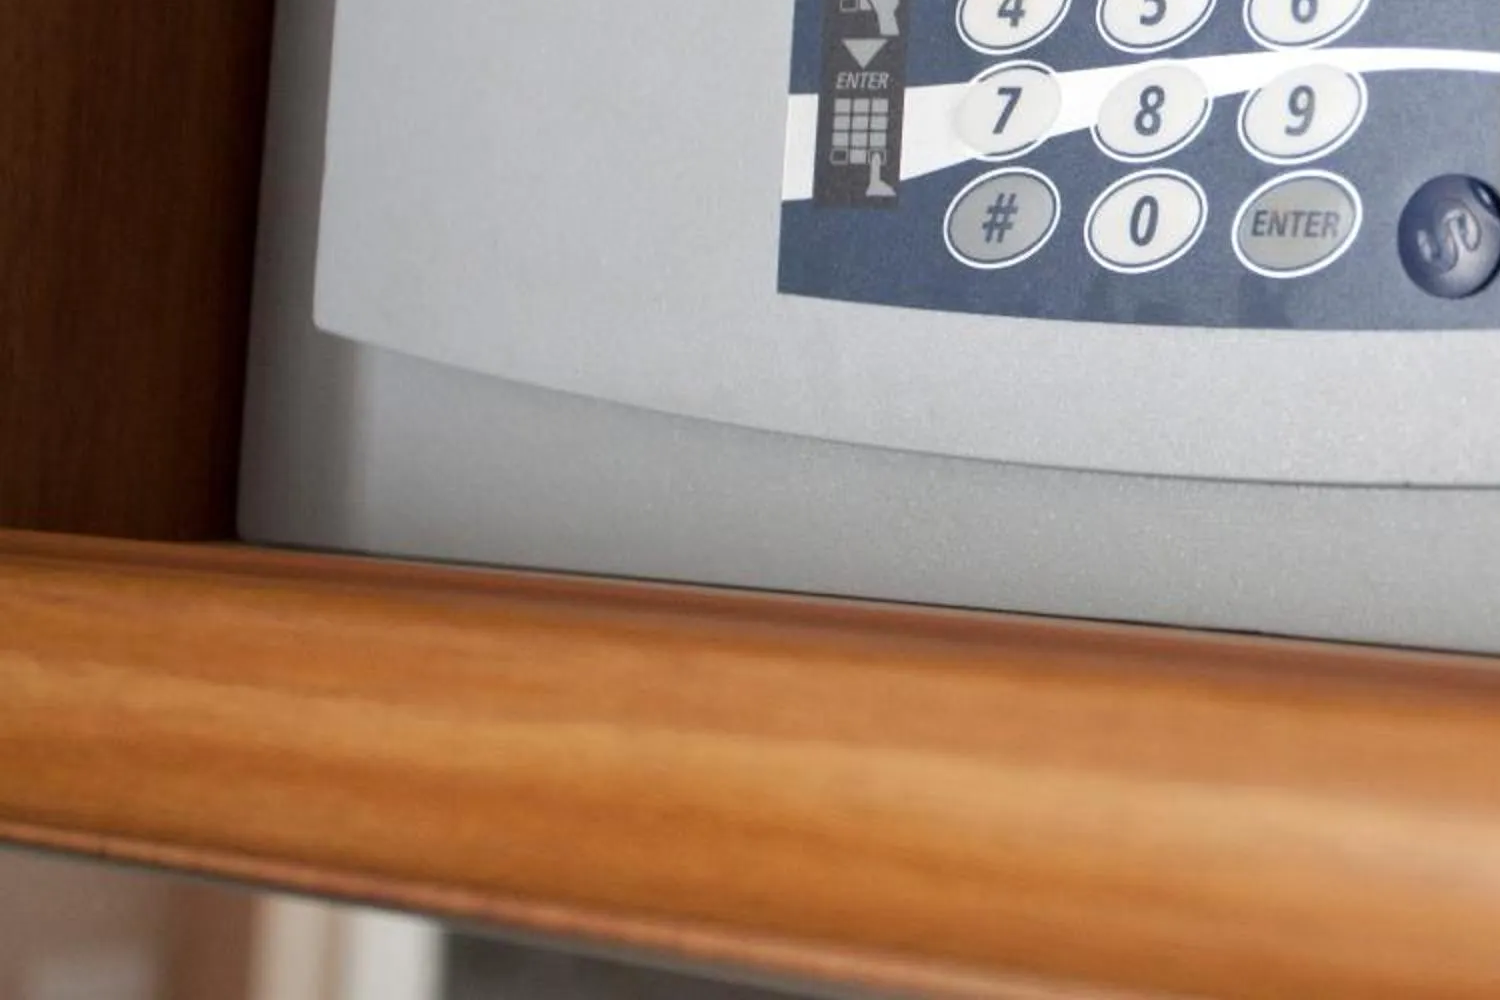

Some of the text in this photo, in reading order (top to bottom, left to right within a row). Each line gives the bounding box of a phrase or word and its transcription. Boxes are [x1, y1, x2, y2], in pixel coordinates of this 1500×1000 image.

[835, 71, 890, 90] ENTER
[991, 86, 1022, 136] 7
[1133, 84, 1167, 138] 8
[1283, 83, 1317, 138] 9
[981, 192, 1020, 244] #
[1128, 194, 1161, 248] 0
[1250, 209, 1342, 239] ENTER
